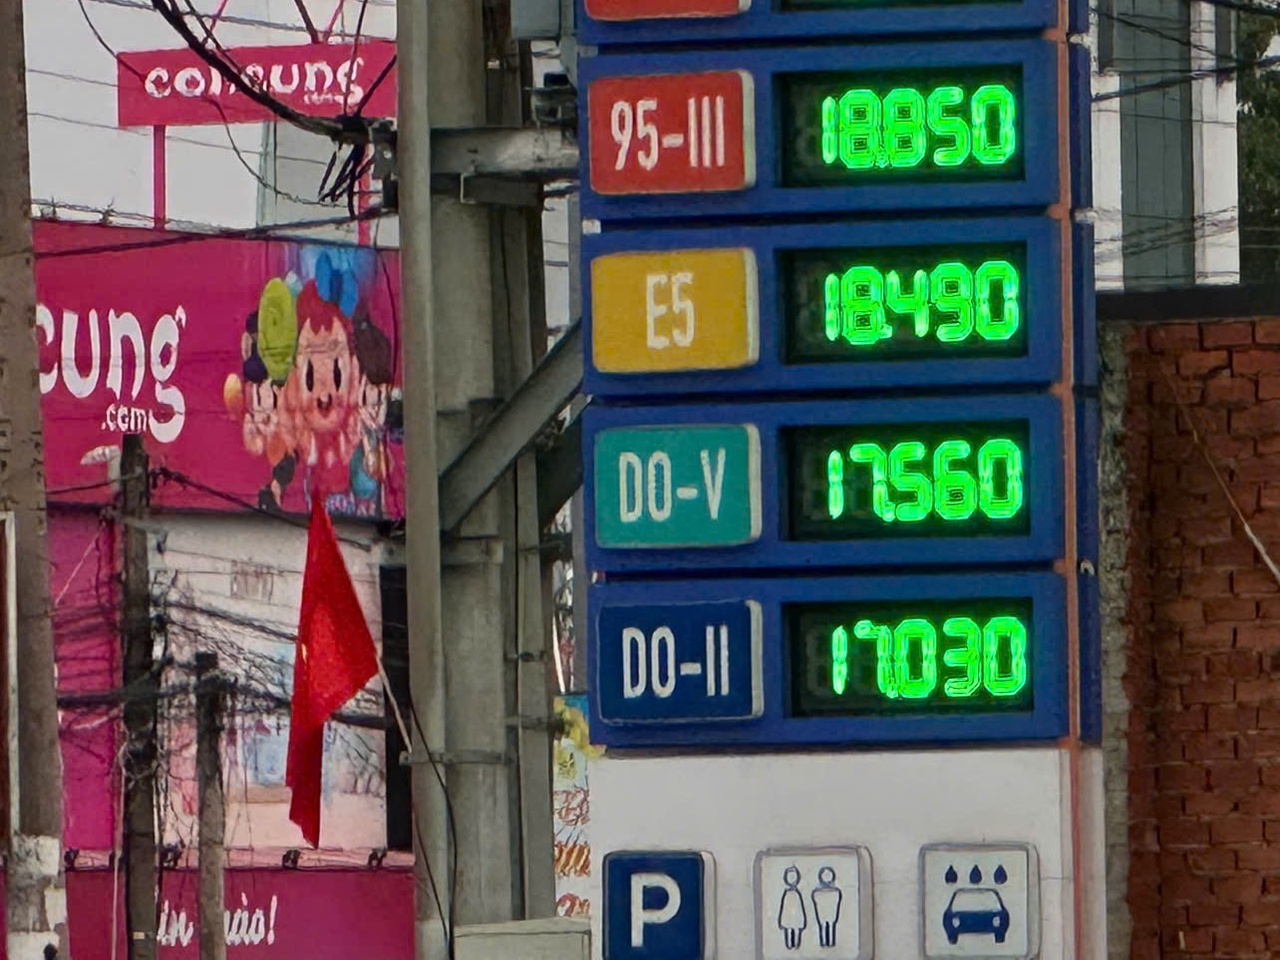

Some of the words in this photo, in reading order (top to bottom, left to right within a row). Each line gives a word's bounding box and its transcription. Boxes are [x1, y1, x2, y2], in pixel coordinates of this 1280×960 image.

[610, 95, 725, 171] 95-III
[645, 272, 696, 350] E5
[618, 448, 726, 523] DO-V
[621, 625, 730, 699] DO-II
[630, 872, 682, 947] P
